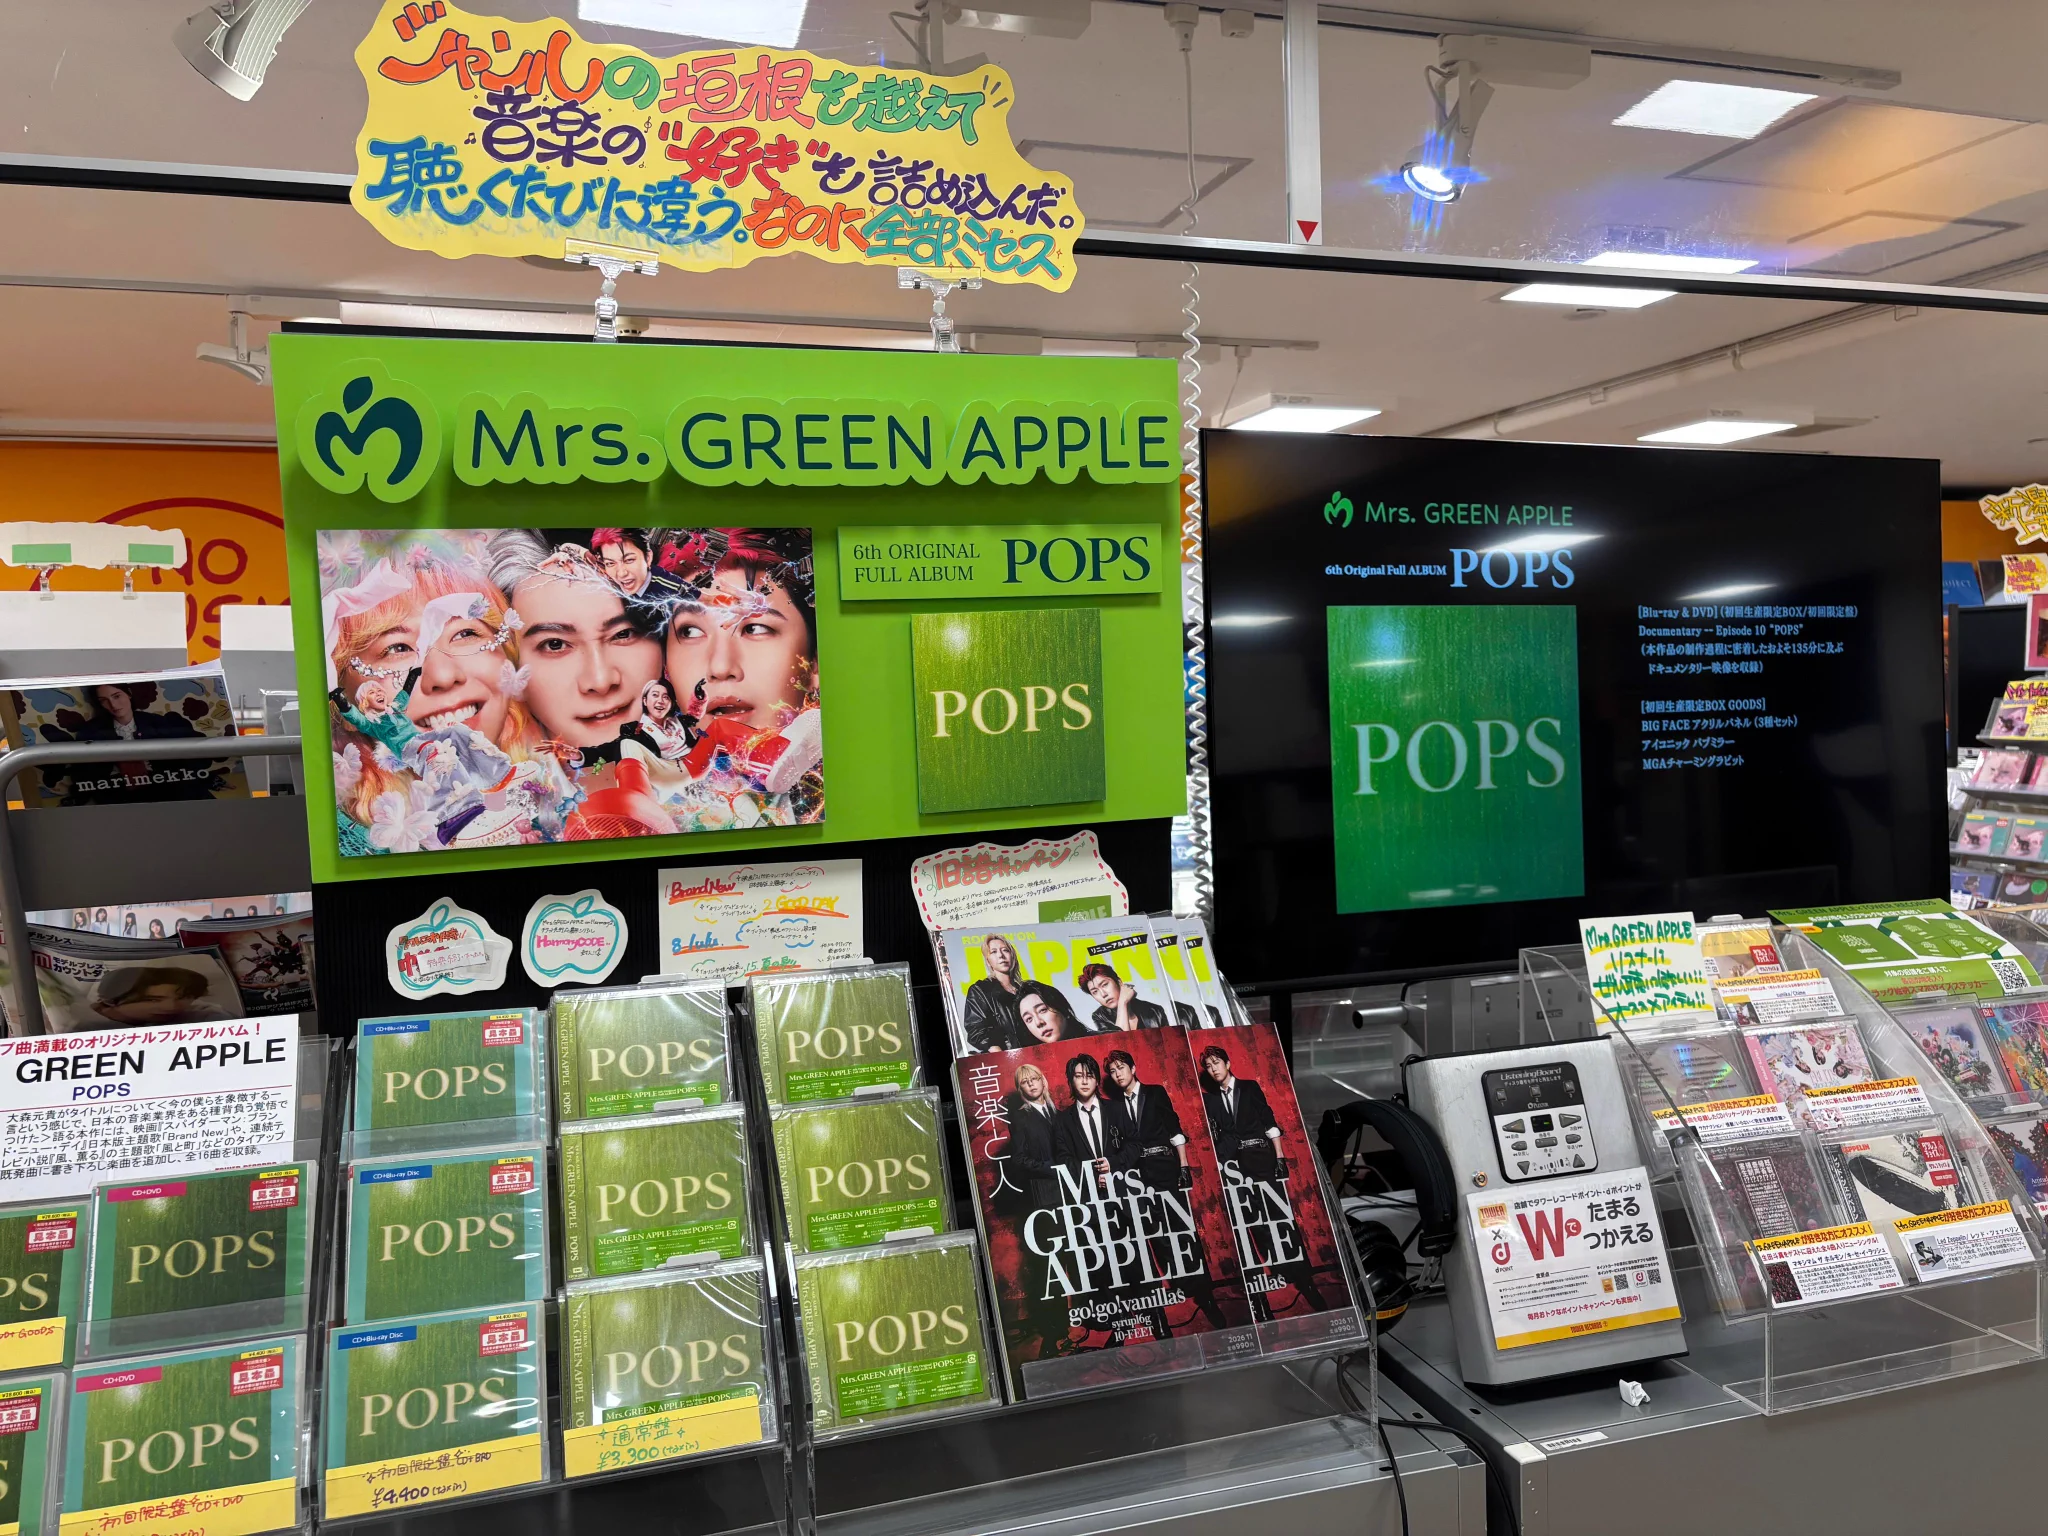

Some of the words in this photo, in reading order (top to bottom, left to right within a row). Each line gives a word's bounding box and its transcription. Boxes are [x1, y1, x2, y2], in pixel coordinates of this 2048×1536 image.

[471, 409, 652, 468] Mrs.
[681, 412, 931, 470] GREEN
[949, 415, 1170, 470] APPLE
[1365, 501, 1416, 523] Mrs.
[1424, 503, 1499, 525] GREEN
[1506, 505, 1573, 526] APPLE
[853, 543, 882, 561] 6th
[888, 541, 980, 561] ORIGINAL
[1002, 536, 1151, 584] POPS
[854, 566, 902, 584] FULL
[906, 564, 975, 583] ALBUM
[1325, 565, 1343, 576] 6th
[1344, 565, 1385, 578] Original
[1387, 565, 1406, 576] Full
[1408, 565, 1447, 576] ALBUM
[1449, 548, 1575, 589] POPS
[1638, 605, 1679, 619] [Blu-ray
[1682, 607, 1690, 618] &
[1692, 605, 1718, 619] DVD]
[1638, 625, 1701, 637] Documentary
[1716, 624, 1752, 636] Episode
[1755, 624, 1766, 635] 10
[930, 683, 1093, 738] POPS
[1728, 697, 1766, 711] GOODS]
[1641, 720, 1660, 731] BIG
[1662, 719, 1690, 731] FACE
[1352, 717, 1565, 796] POPS
[76, 767, 210, 793] marimekko
[776, 895, 809, 911] GOOD
[1656, 919, 1693, 944] APPLE
[784, 1021, 902, 1063] POPS
[16, 1049, 146, 1084] GREEN
[168, 1037, 287, 1072] APPLE
[587, 1038, 714, 1082] POPS
[830, 1068, 852, 1077] APPLE
[869, 1064, 889, 1073] POPS
[72, 1082, 131, 1100] POPS
[383, 1063, 507, 1104] POPS
[633, 1089, 658, 1098] APPLE
[676, 1086, 697, 1095] POPS
[562, 1091, 572, 1115] POPS
[968, 1061, 1023, 1199] 音楽と人
[407, 1169, 420, 1178] Disc
[805, 1154, 931, 1203] POPS
[131, 1186, 162, 1197] CD+DVD
[596, 1172, 731, 1223] POPS
[854, 1208, 879, 1218] APPLE
[896, 1203, 917, 1211] POPS
[1023, 1187, 1197, 1257] GREEN
[1587, 1196, 1641, 1223] たまる
[380, 1213, 515, 1262] POPS
[644, 1229, 672, 1240] APPLE
[692, 1224, 714, 1234] POPS
[1516, 1207, 1565, 1261] W
[1583, 1222, 1654, 1250] つかえる
[126, 1230, 276, 1285] POPS
[569, 1235, 579, 1268] POPS
[1040, 1232, 1204, 1301] APPLE
[1068, 1287, 1187, 1327] go!go!vanillas
[833, 1305, 969, 1363] POPS
[1111, 1313, 1152, 1330] syrup16g
[1114, 1326, 1155, 1344] 10-FEET
[352, 1333, 388, 1345] CD+Blu-ray
[389, 1331, 404, 1340] Disc
[487, 1331, 521, 1345] 見本品
[604, 1334, 751, 1395] POPS
[807, 1337, 819, 1369] APPLE
[102, 1373, 135, 1385] CD+DVD
[238, 1367, 276, 1383] 見本品
[887, 1365, 913, 1377] APPLE
[932, 1358, 955, 1369] POPS
[574, 1363, 584, 1404] APPLE
[812, 1376, 823, 1404] POPS
[359, 1377, 507, 1437] POPS
[657, 1401, 685, 1413] APPLE
[707, 1392, 731, 1403] POPS
[612, 1417, 673, 1447] 通常盤
[97, 1416, 259, 1484] POPS
[597, 1446, 660, 1470] ¥3,300
[372, 1485, 430, 1508] ¥4,400
[99, 1499, 191, 1532] 初回限定盤
